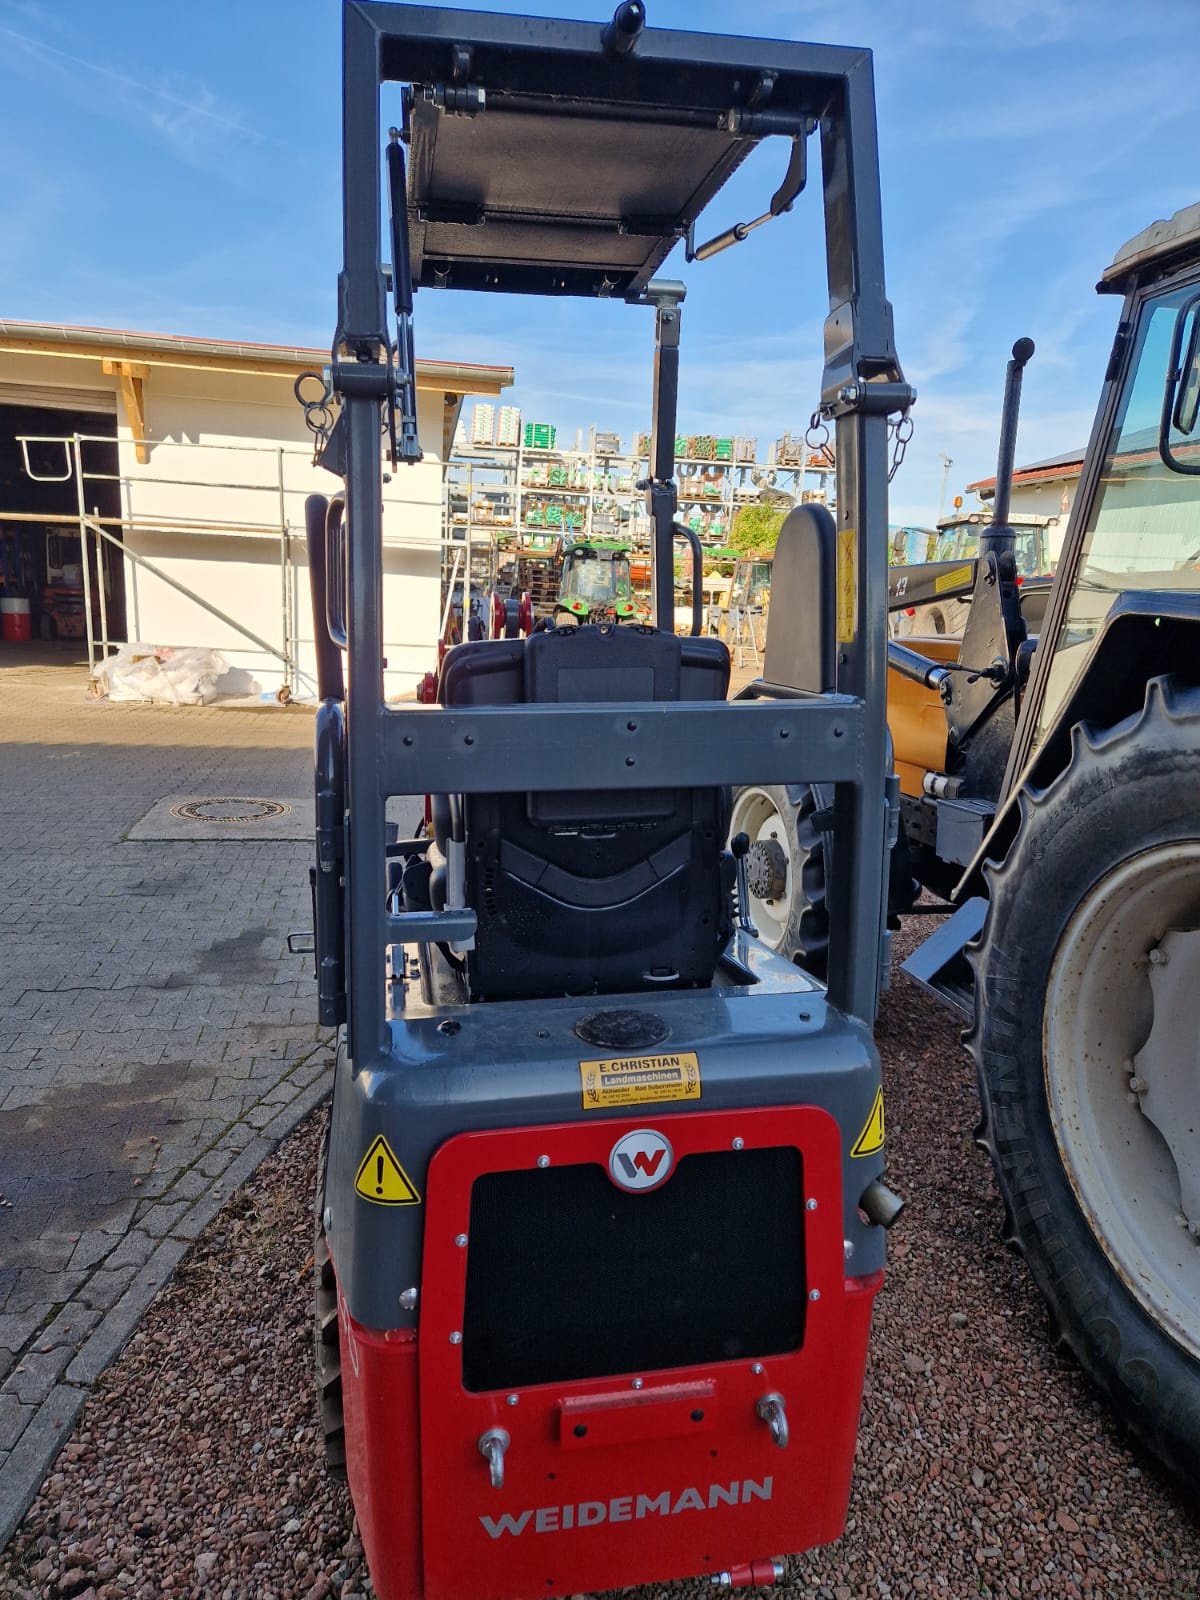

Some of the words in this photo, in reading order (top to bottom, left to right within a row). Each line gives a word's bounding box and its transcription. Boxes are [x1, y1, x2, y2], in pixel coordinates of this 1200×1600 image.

[604, 1071, 679, 1085] Landmaschinen
[616, 1149, 666, 1179] W
[479, 1476, 774, 1540] WEIDEMANN
